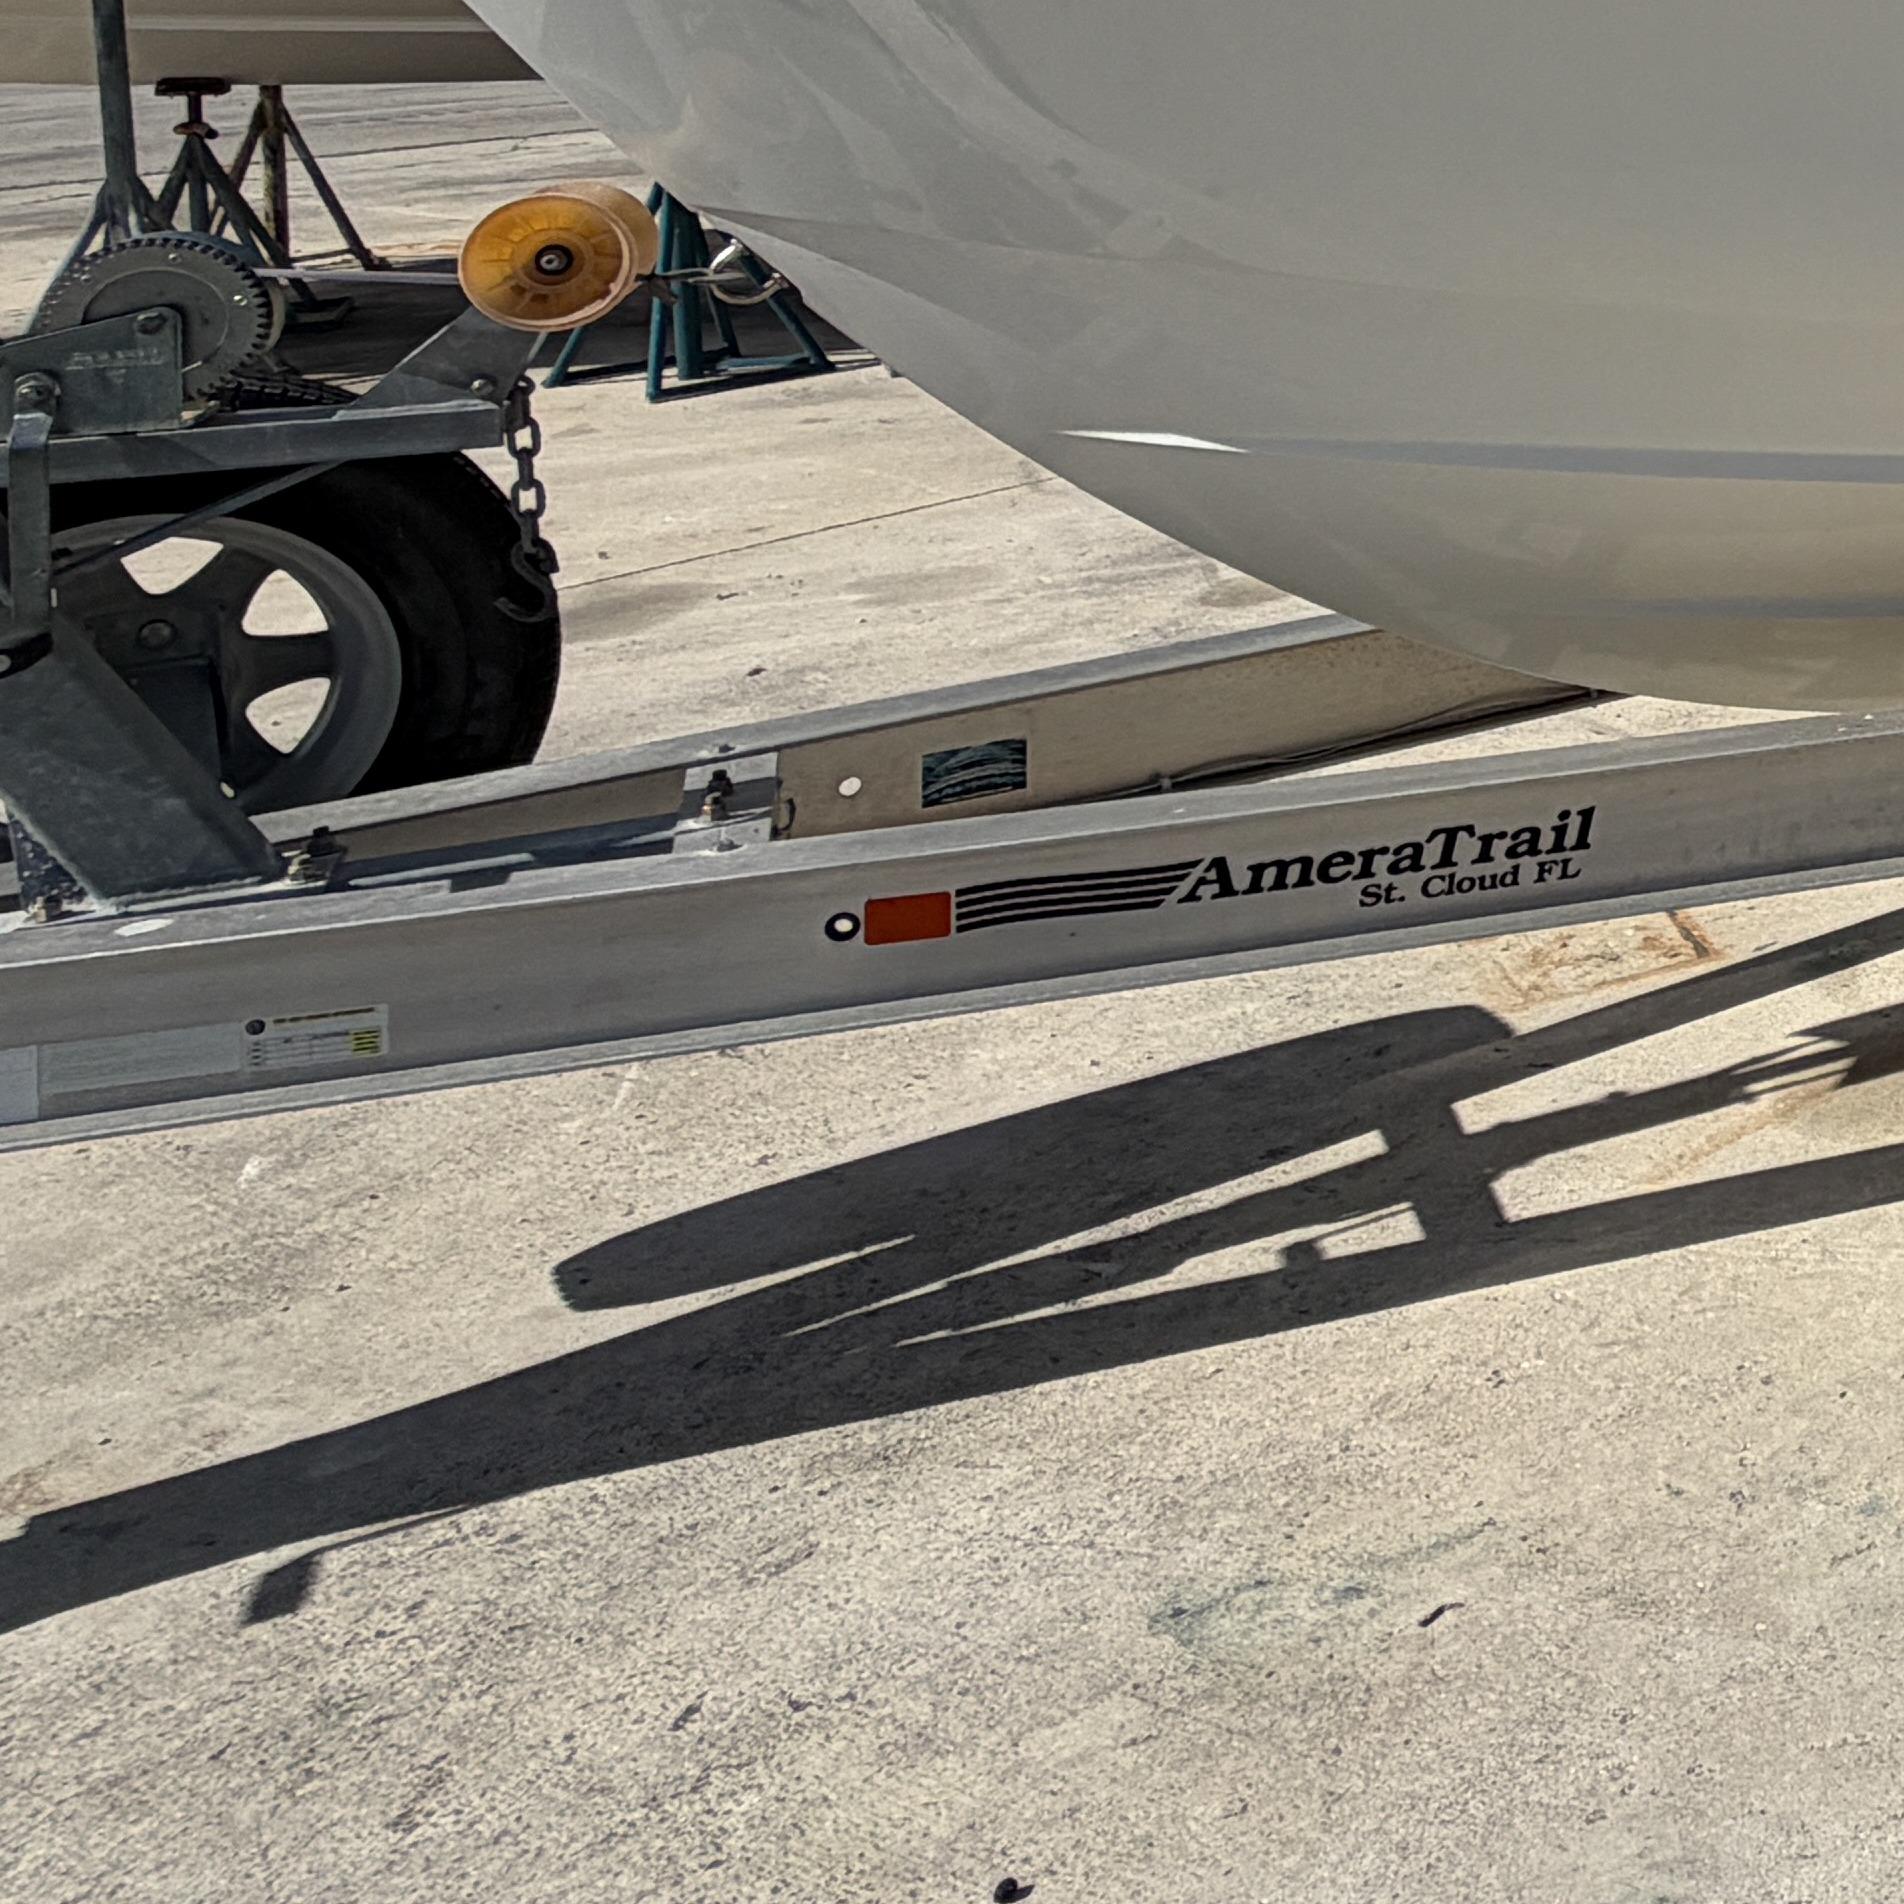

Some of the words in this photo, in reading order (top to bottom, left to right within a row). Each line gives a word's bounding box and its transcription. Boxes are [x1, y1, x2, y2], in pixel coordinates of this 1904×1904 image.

[1177, 805, 1597, 904] AmeraTrail
[1358, 882, 1406, 908] St.
[1420, 863, 1520, 898] Cloud
[1534, 857, 1582, 884] FL
